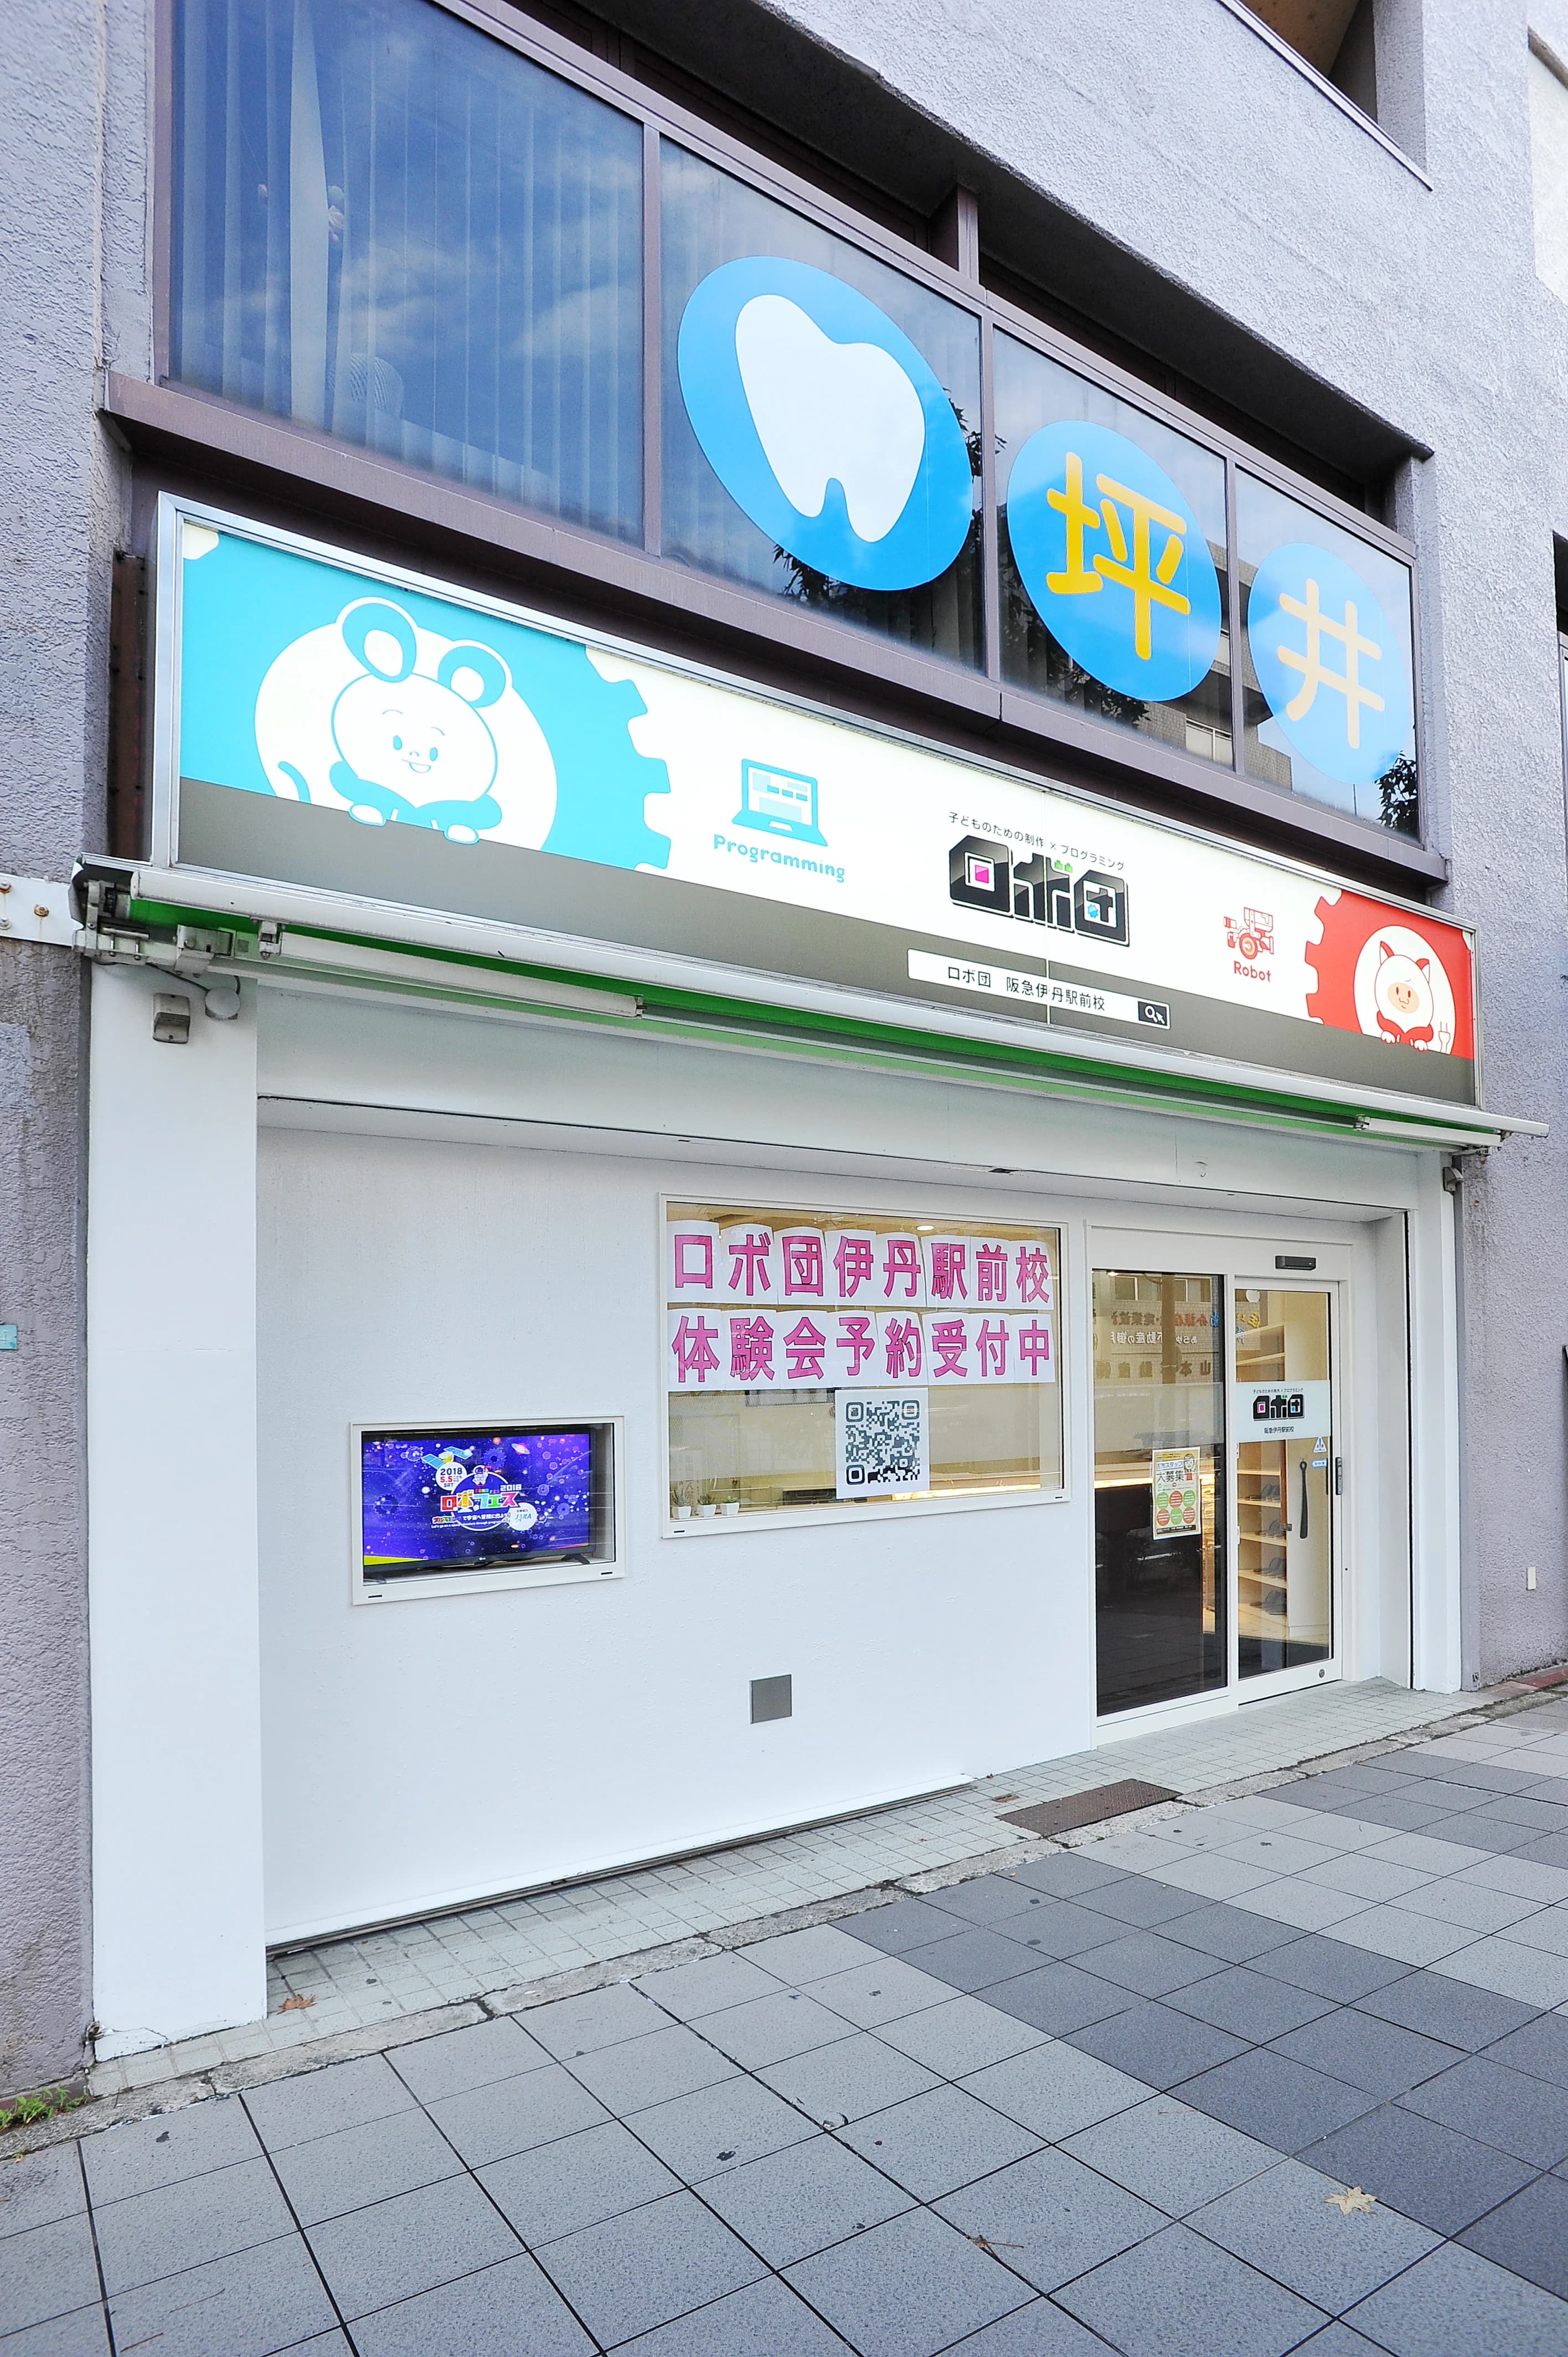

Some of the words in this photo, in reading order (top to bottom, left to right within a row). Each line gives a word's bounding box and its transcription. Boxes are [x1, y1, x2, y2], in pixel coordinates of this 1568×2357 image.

[1047, 452, 1190, 660] 坪
[1278, 578, 1384, 749] 井
[714, 833, 845, 883] Programming
[948, 811, 1045, 848] 子どものための制作
[1061, 845, 1125, 871] プログラミング
[948, 966, 991, 989] ロボ団
[1006, 977, 1106, 1011] 阪急伊丹駅前校
[1234, 961, 1272, 982] Robot
[674, 1232, 1050, 1303] ロボ団伊丹駅前校
[672, 1315, 1050, 1383] 体験会予約受付中
[440, 1467, 462, 1475] 2018
[1157, 1470, 1184, 1483] 大募集
